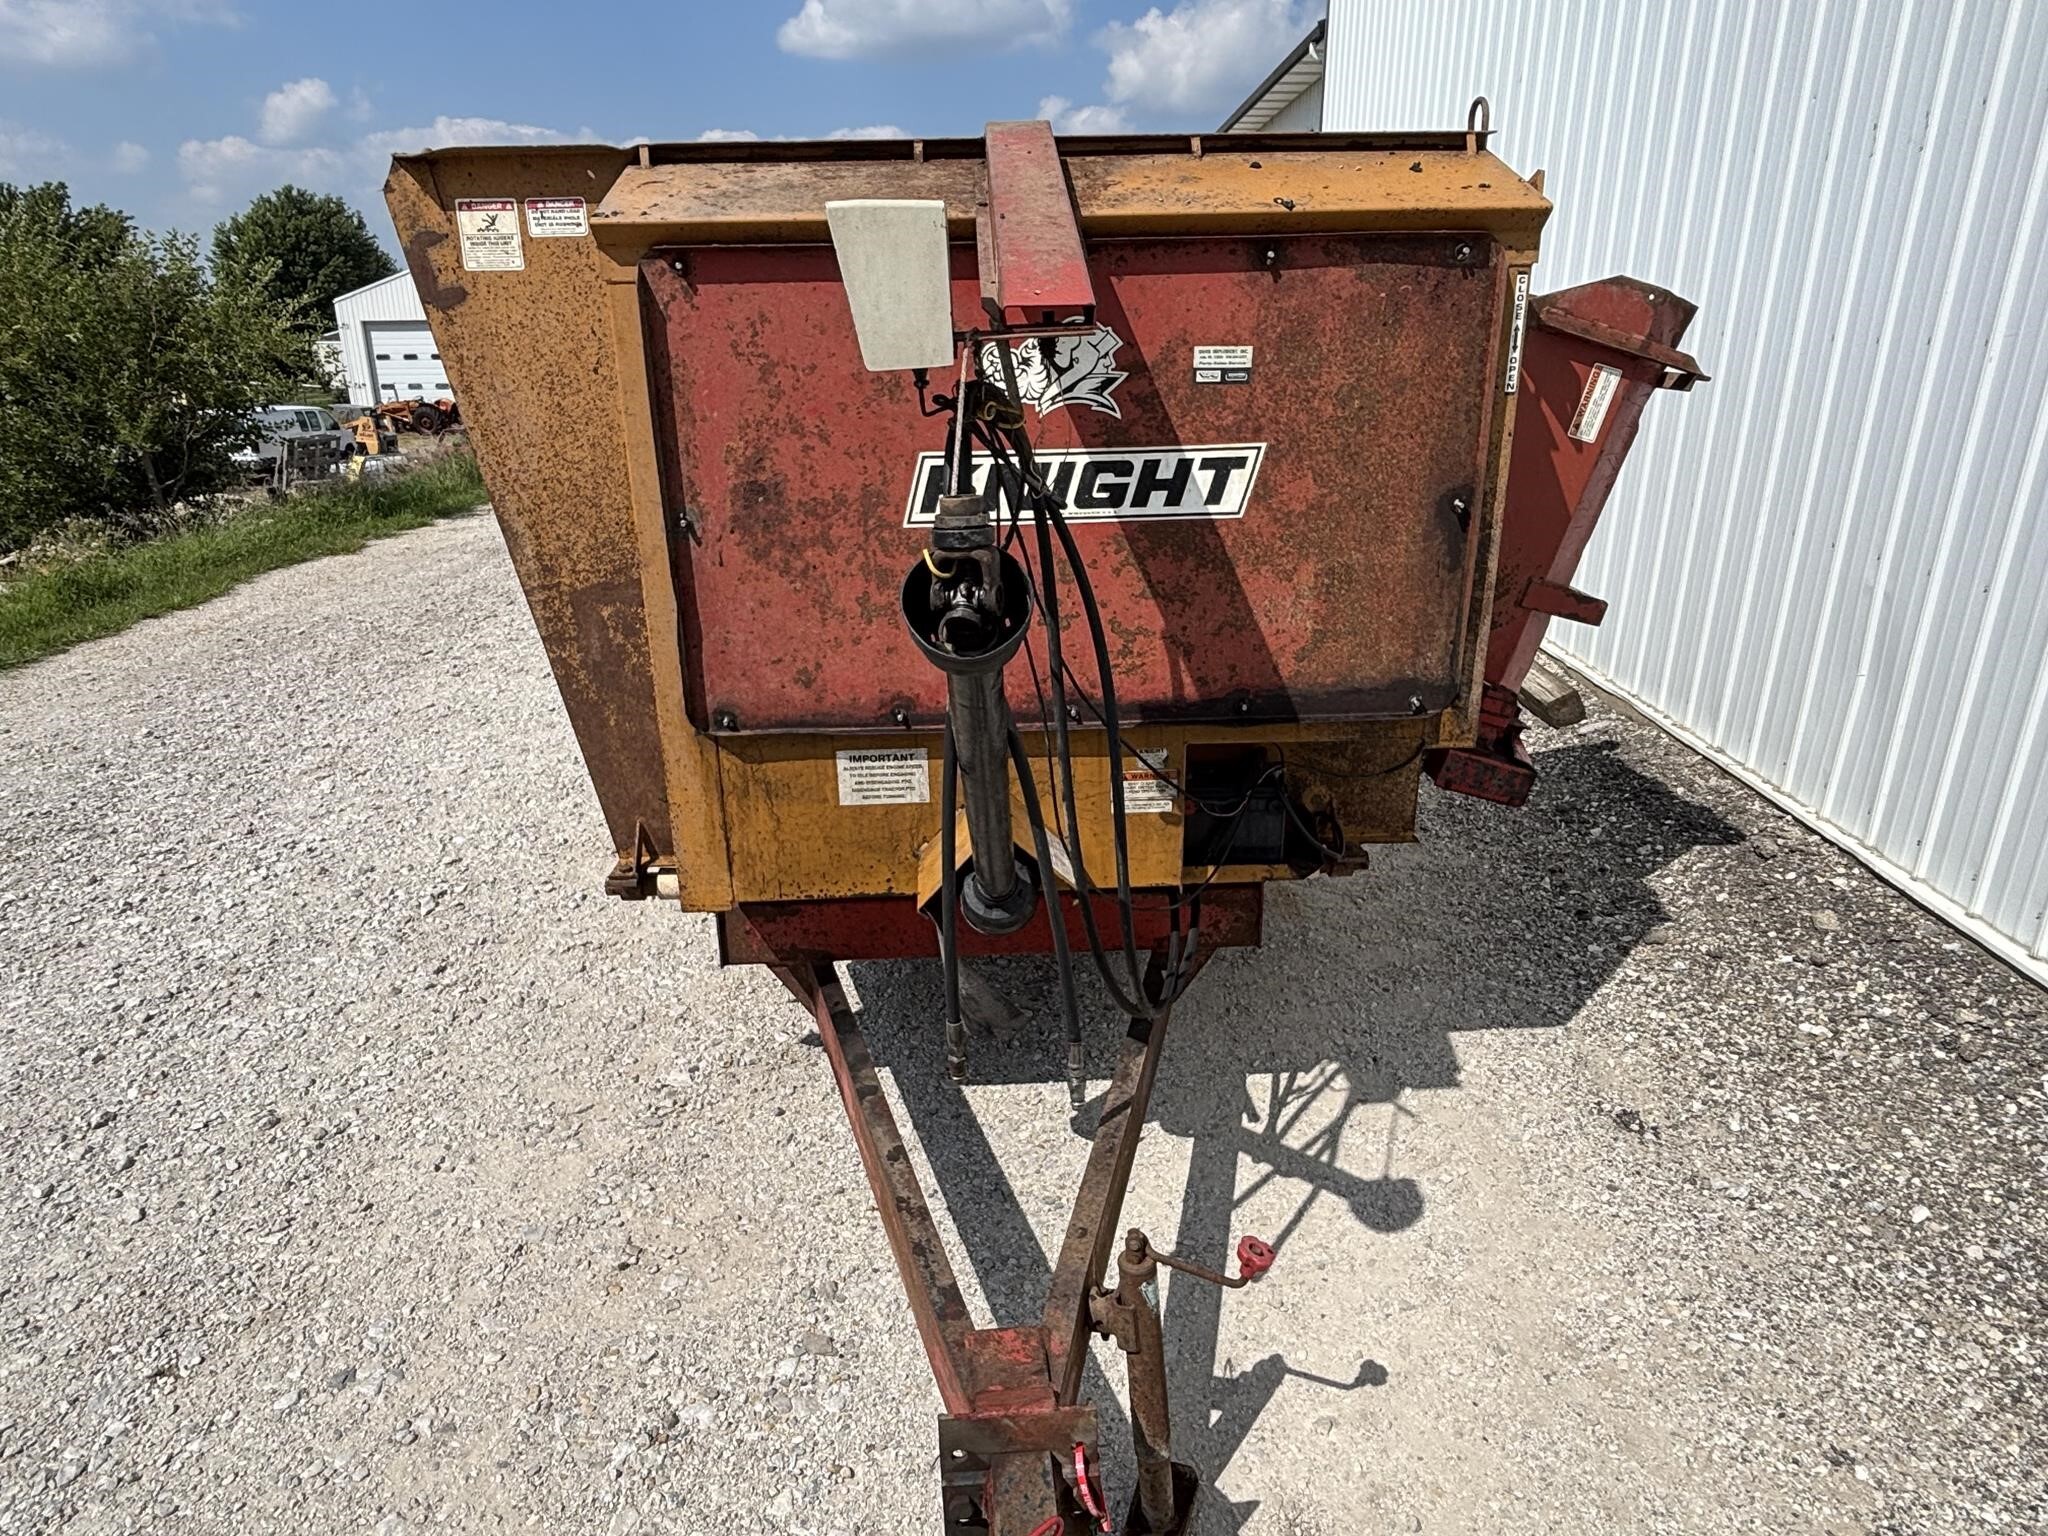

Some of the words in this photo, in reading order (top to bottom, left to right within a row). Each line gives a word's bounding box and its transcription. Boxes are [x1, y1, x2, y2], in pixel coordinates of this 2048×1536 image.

[1515, 276, 1526, 320] CLOSE
[1506, 356, 1518, 390] OPEN
[1577, 371, 1601, 417] WARNING
[849, 752, 916, 763] IMPORTANT
